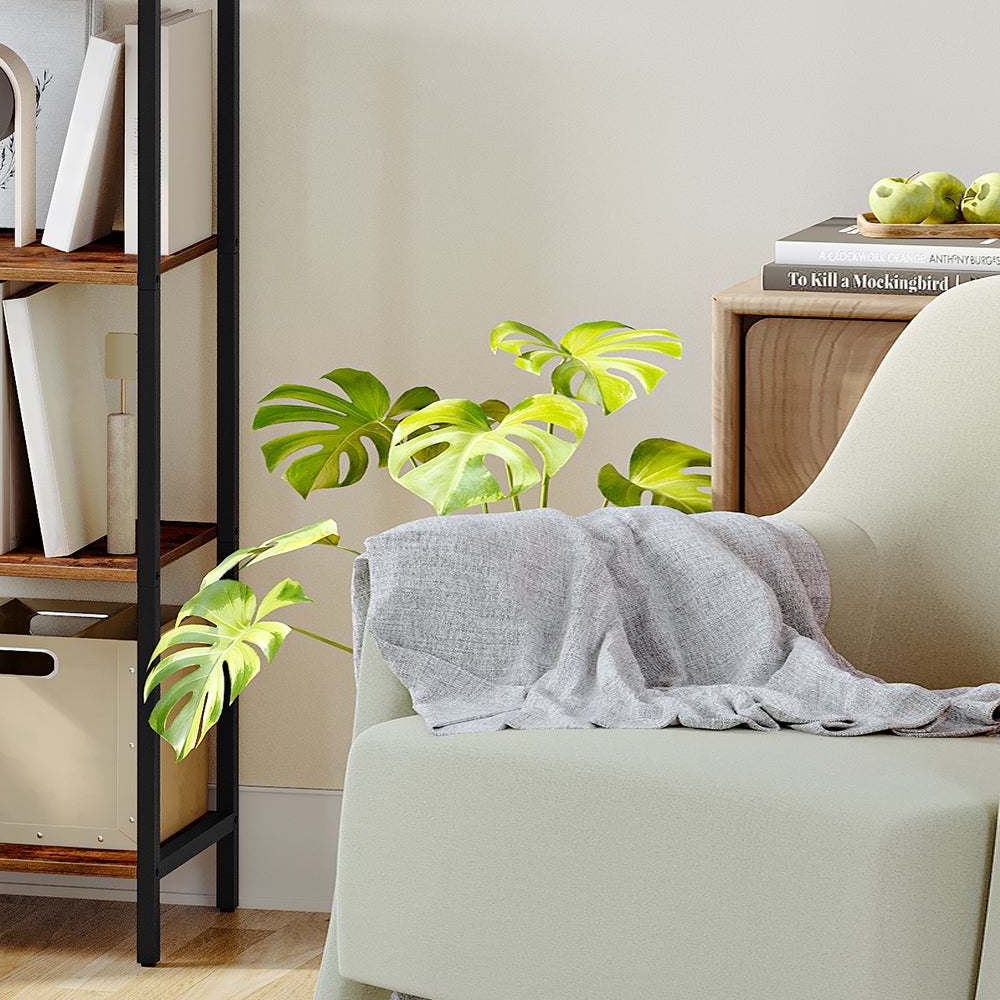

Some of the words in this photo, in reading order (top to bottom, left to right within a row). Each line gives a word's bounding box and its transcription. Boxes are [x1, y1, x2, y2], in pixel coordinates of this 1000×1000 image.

[787, 272, 808, 288] To
[811, 273, 838, 288] Kill
[841, 278, 850, 288] a
[853, 274, 949, 293] Mockingbird
